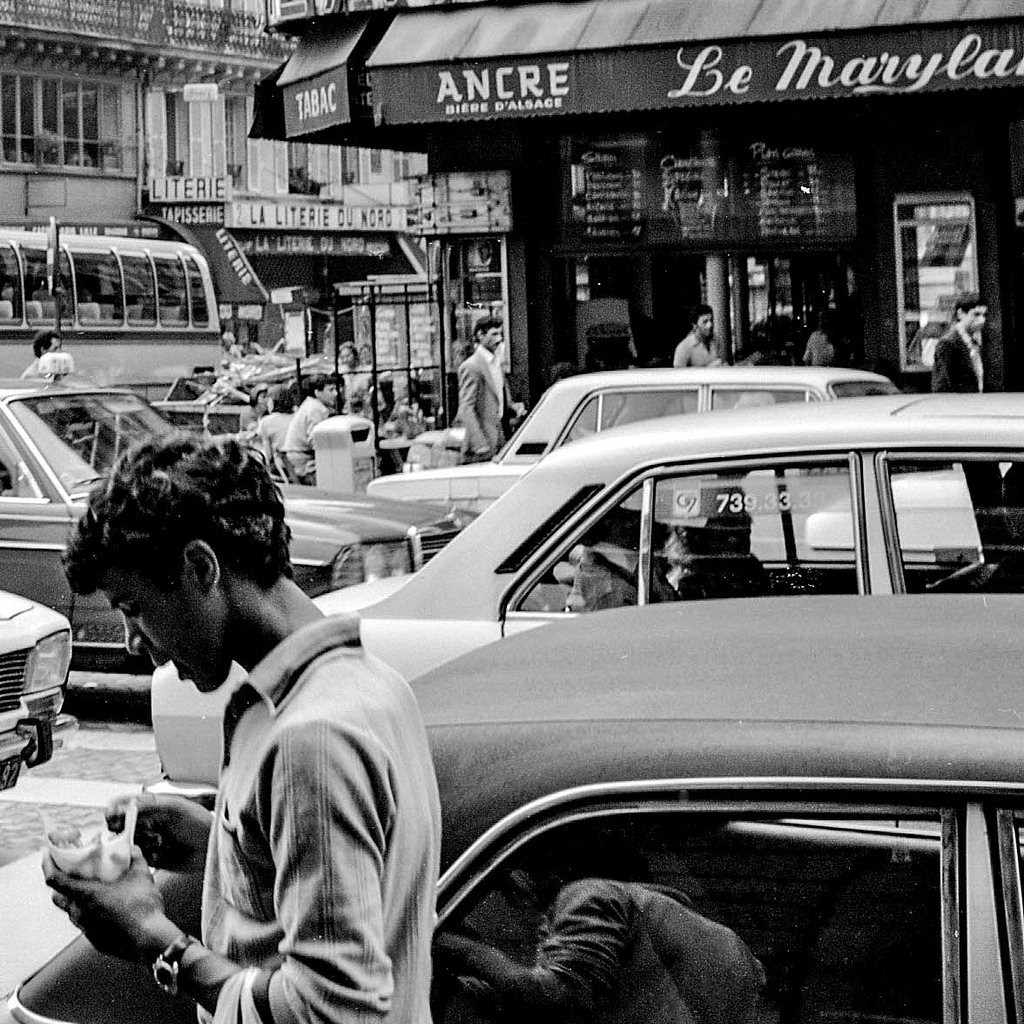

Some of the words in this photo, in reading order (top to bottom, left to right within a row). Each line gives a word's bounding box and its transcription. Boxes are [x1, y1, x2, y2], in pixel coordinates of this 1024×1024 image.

[436, 62, 570, 103] ANCRE
[668, 45, 752, 97] Le
[295, 82, 337, 120] TABAC
[495, 97, 562, 111] D'ALSACE
[152, 178, 225, 199] LITERIE
[162, 205, 224, 224] TAPISSERIE
[250, 206, 266, 225] LA
[276, 206, 330, 226] LITERIE
[338, 208, 353, 227] DU
[361, 209, 392, 227] NORD
[216, 228, 253, 286] LITERIE
